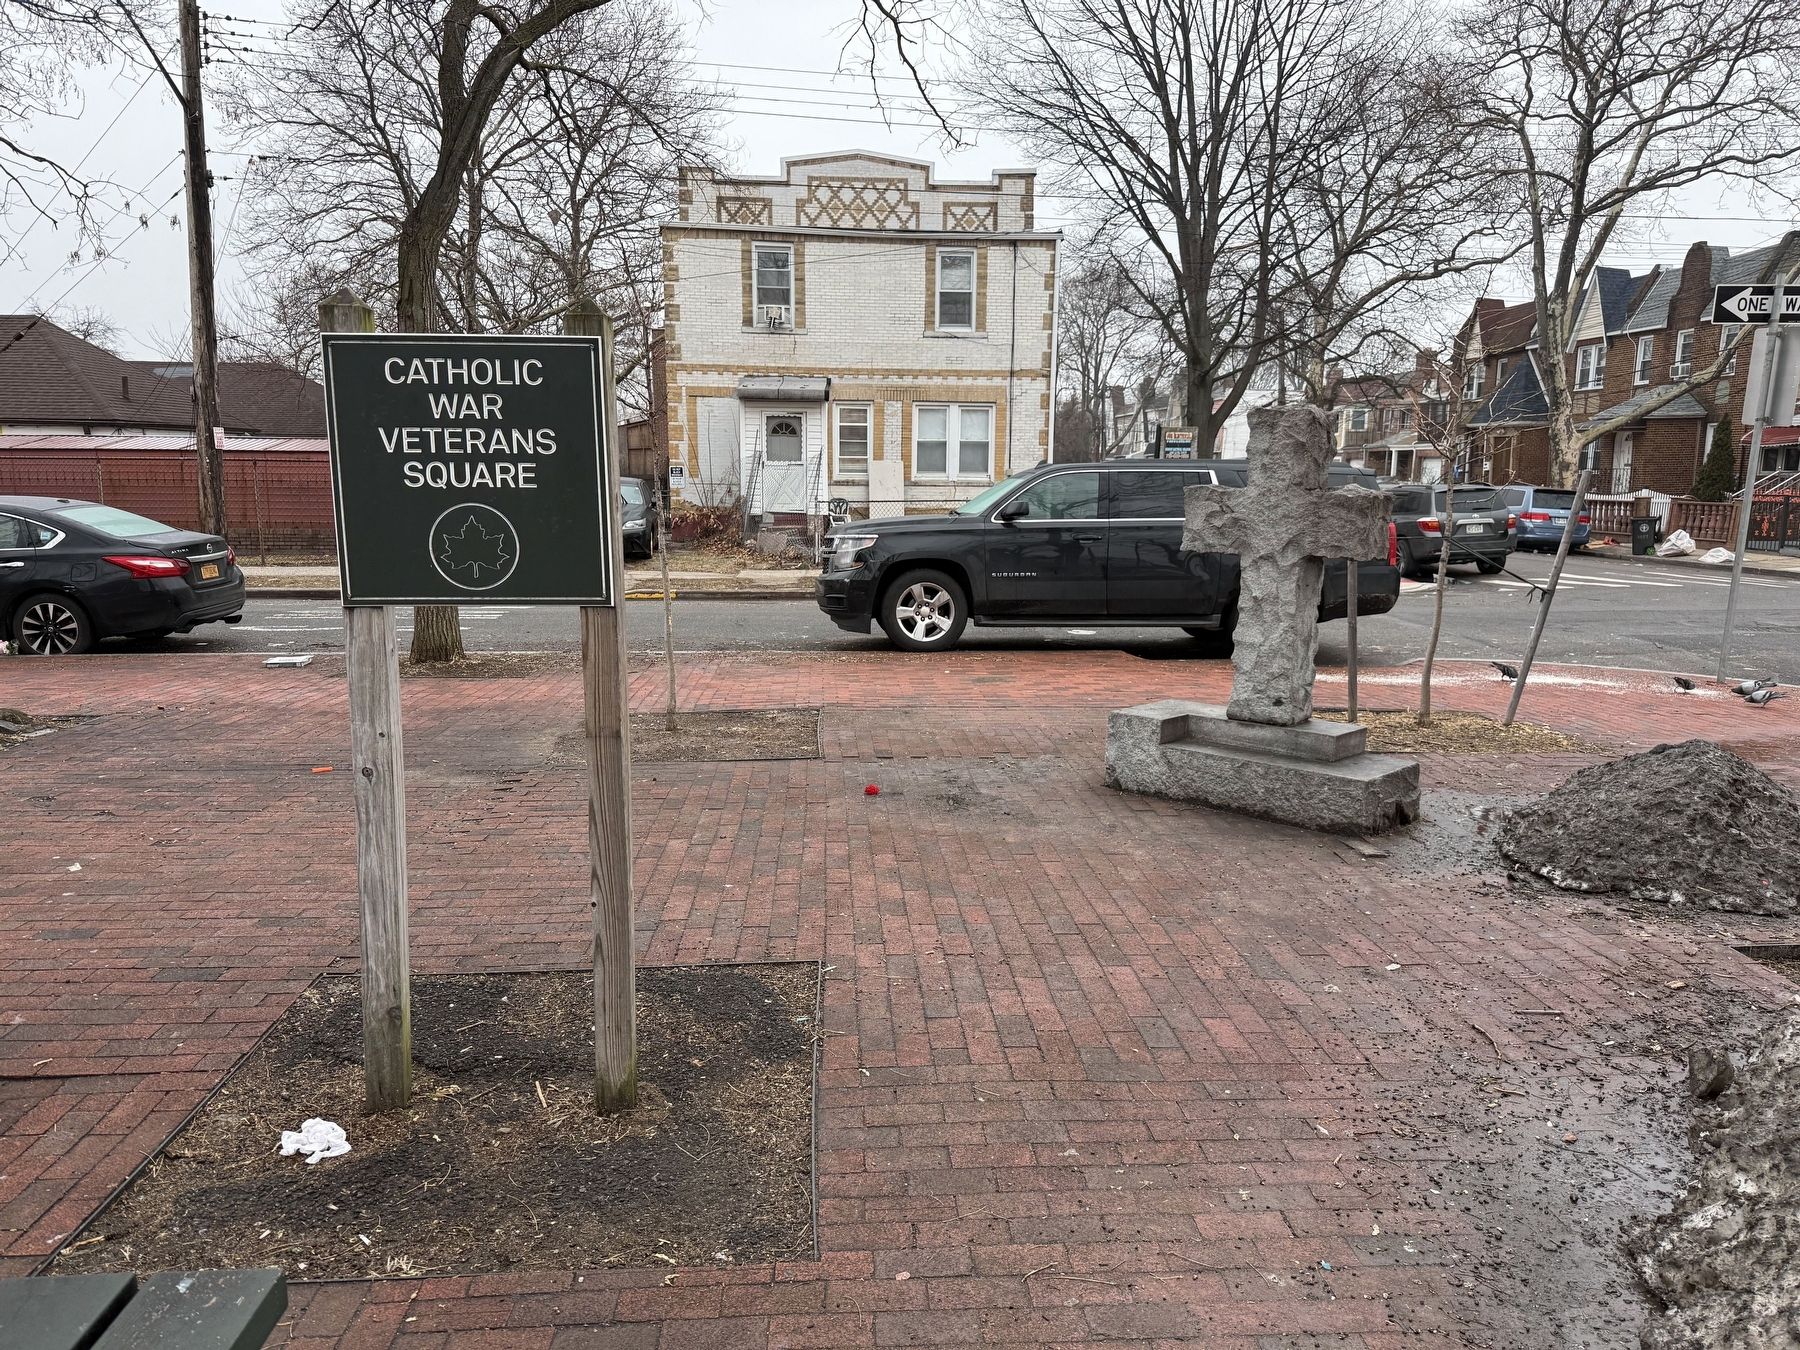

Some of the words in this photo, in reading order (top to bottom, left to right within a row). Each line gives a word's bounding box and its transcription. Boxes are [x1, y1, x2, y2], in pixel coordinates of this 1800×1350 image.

[1737, 297, 1769, 312] ONE
[384, 356, 544, 386] CATHOLIC
[428, 393, 504, 420] WAR
[378, 426, 557, 455] VETERANS
[403, 461, 538, 490] SQUARE
